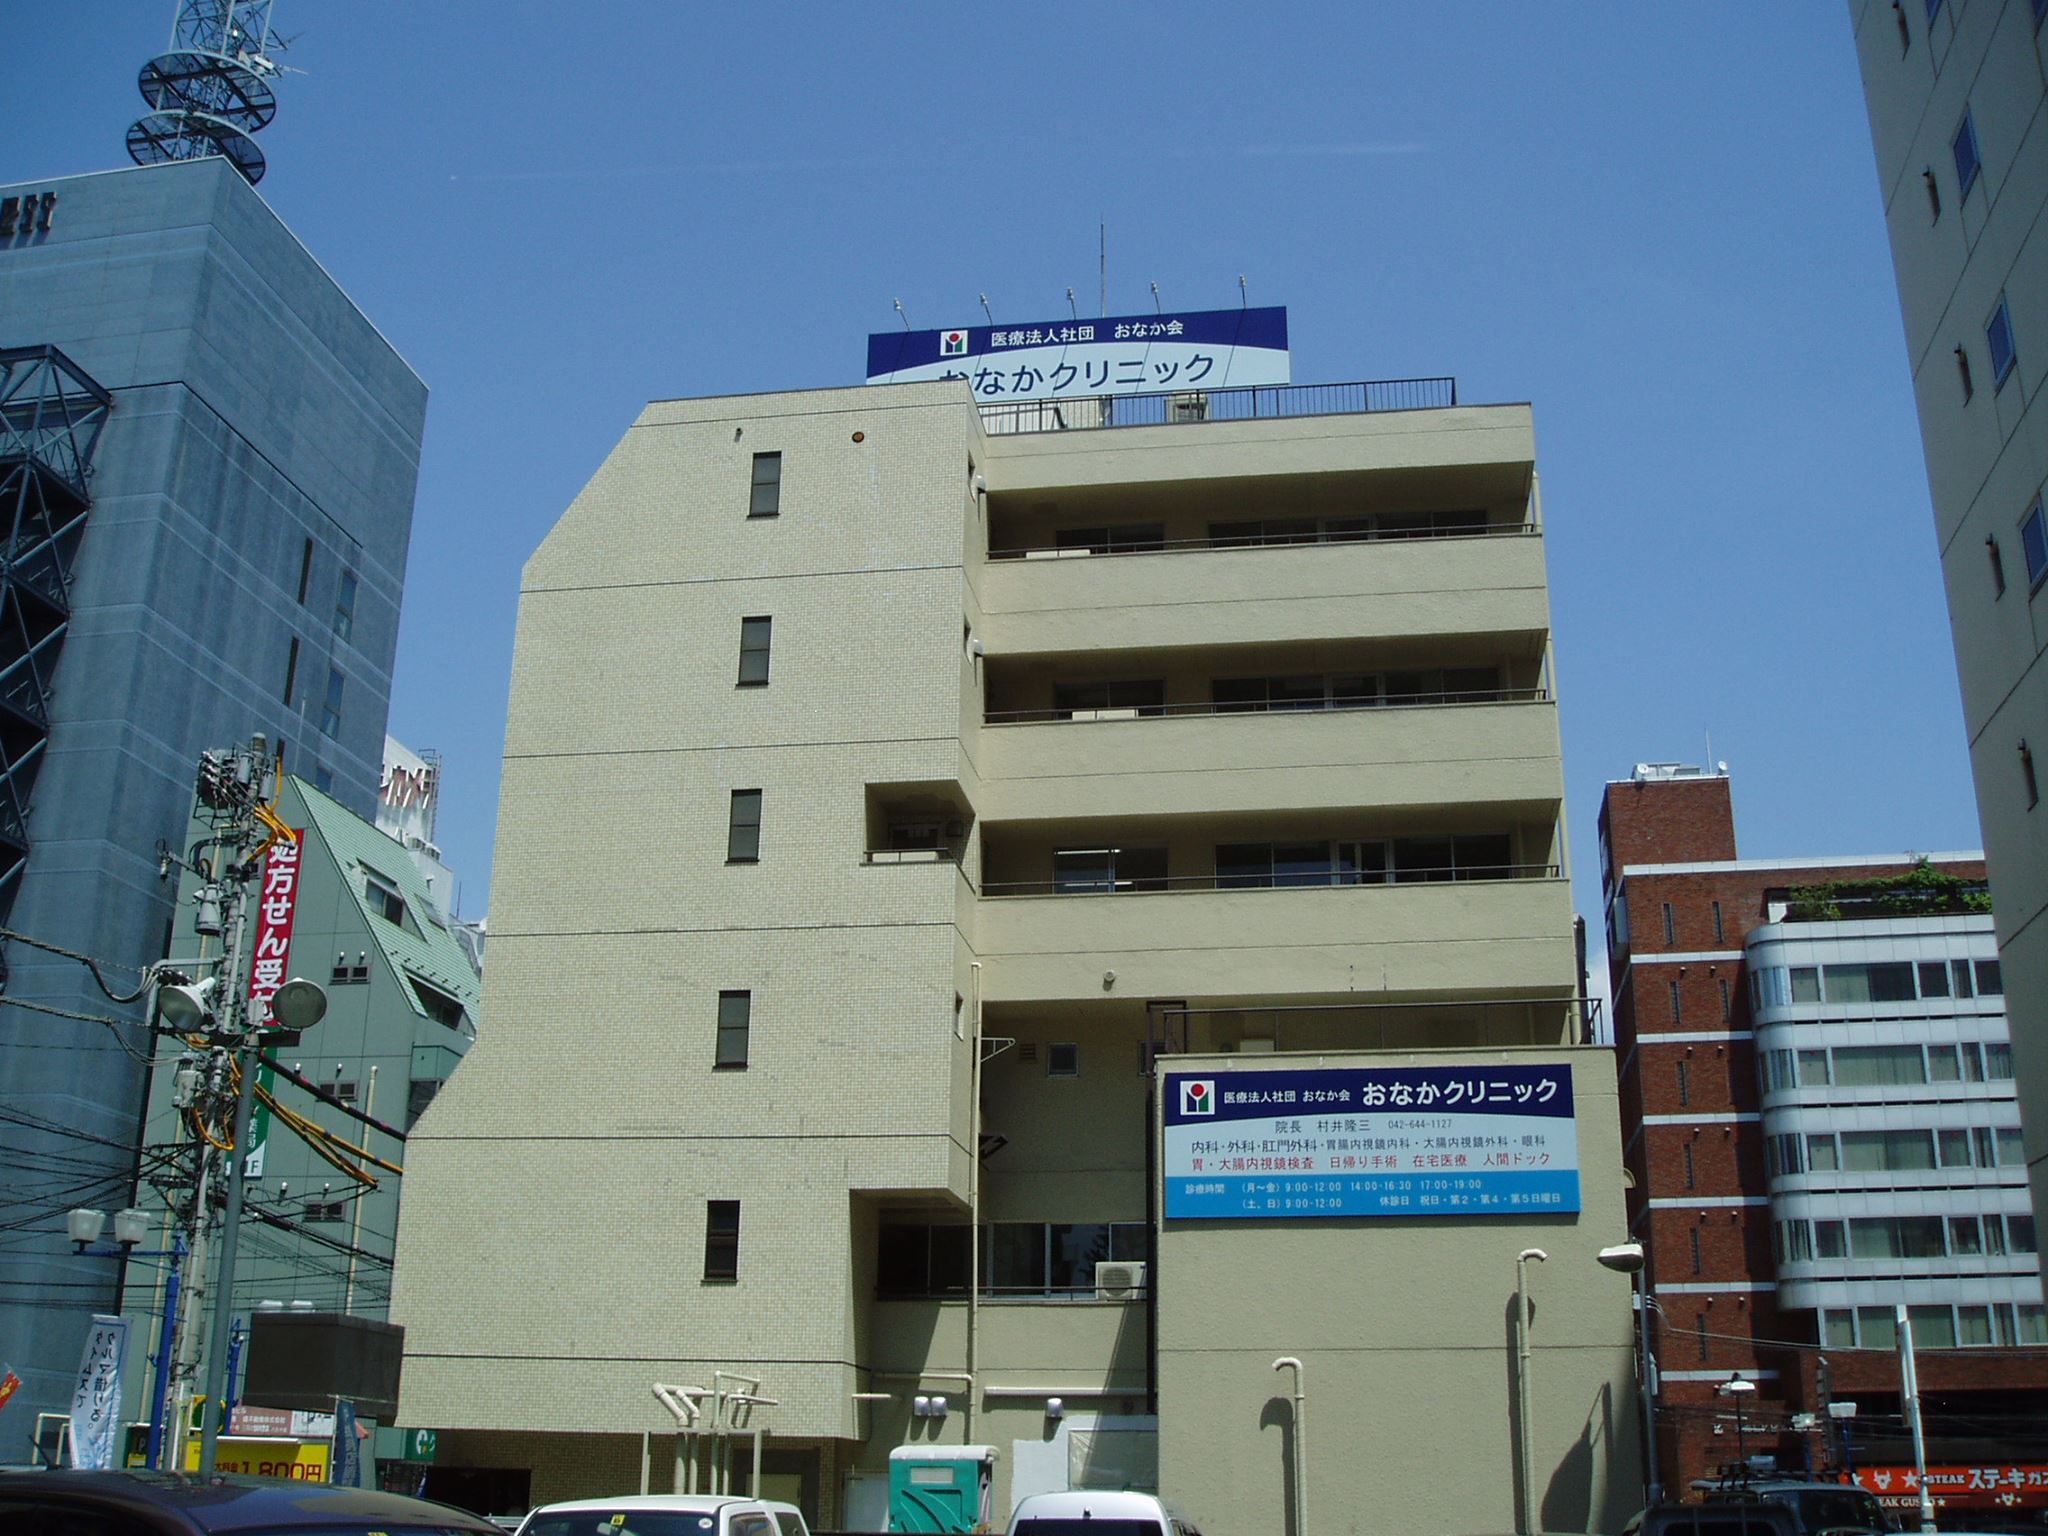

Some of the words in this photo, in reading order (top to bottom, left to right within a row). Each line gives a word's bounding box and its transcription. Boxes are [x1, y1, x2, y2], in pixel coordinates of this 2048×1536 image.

[991, 325, 1094, 347] 医療法人社団
[1114, 320, 1184, 338] おなか会
[1224, 1090, 1296, 1104] 医療法人社団
[1302, 1089, 1351, 1102] おなか会
[1362, 1078, 1557, 1106] おなかクリニック
[1275, 1120, 1302, 1134] 院長
[1317, 1119, 1371, 1133] 村井隆三
[1388, 1119, 1452, 1130] 042-644-1127
[1330, 1155, 1398, 1169] 日帰り手術
[1412, 1153, 1468, 1168] 在宅医療
[1483, 1152, 1551, 1166] 人間ドック
[1185, 1184, 1226, 1195] 診療時間
[1285, 1182, 1342, 1192] 9:00-12:00
[1350, 1180, 1412, 1191] 14:00-16:30
[1420, 1179, 1482, 1190] 17:00-19:00
[1285, 1198, 1342, 1208] 9:00-12:00
[1379, 1195, 1410, 1207] 休診日
[241, 1461, 322, 1483] 1800円
[1879, 1497, 1899, 1507] EAK
[1901, 1497, 1936, 1507] GUSO
